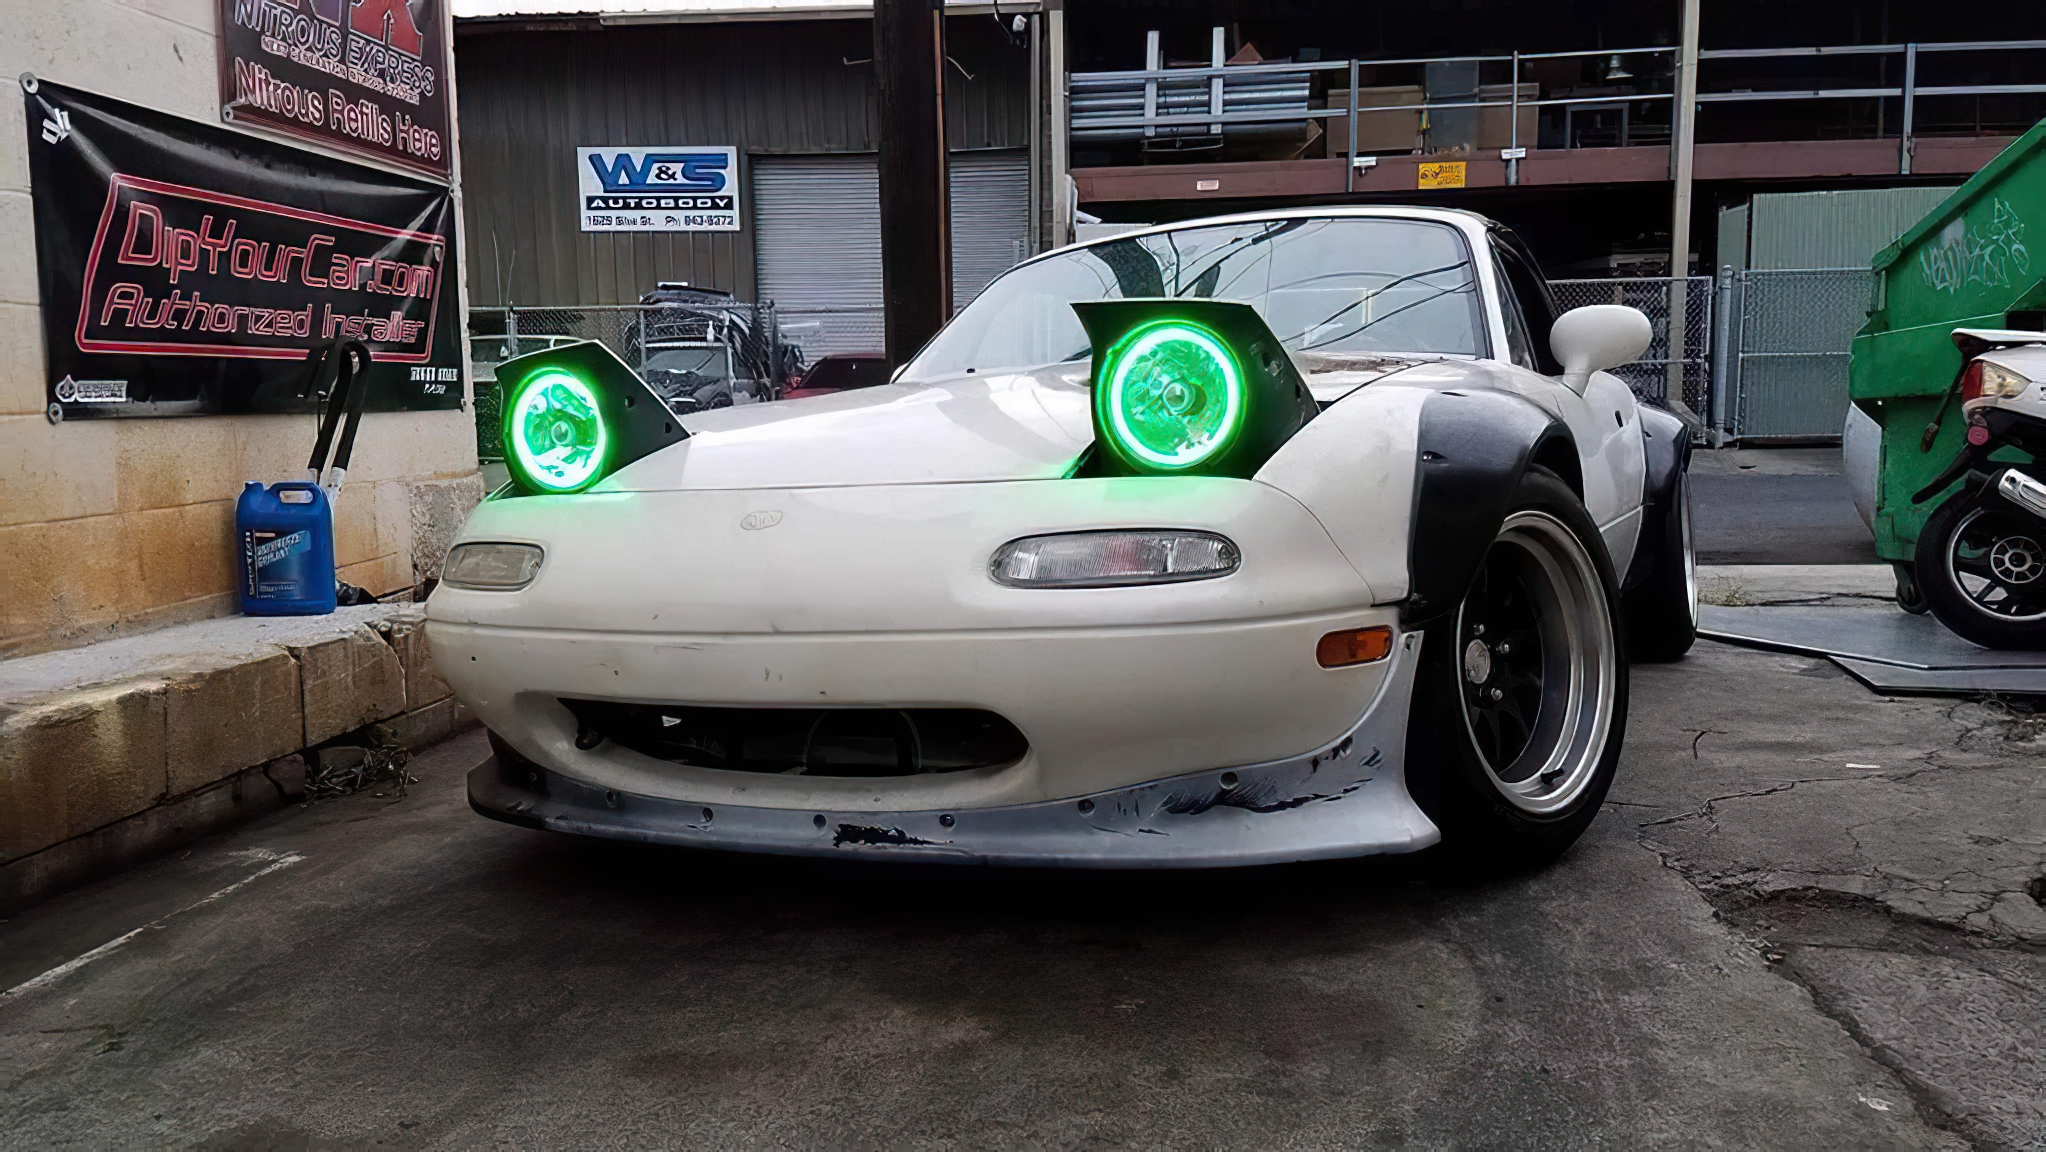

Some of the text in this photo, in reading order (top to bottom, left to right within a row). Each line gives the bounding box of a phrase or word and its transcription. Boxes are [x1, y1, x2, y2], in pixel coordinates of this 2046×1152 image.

[234, 0, 342, 61] NITROUS
[234, 56, 324, 126] Nitrous
[328, 88, 393, 147] Refills
[396, 111, 441, 161] Here
[588, 152, 729, 194] W&S
[589, 198, 730, 209] AUTOBODY
[117, 200, 435, 299] DipYourCar.com
[100, 282, 313, 338] Authorized
